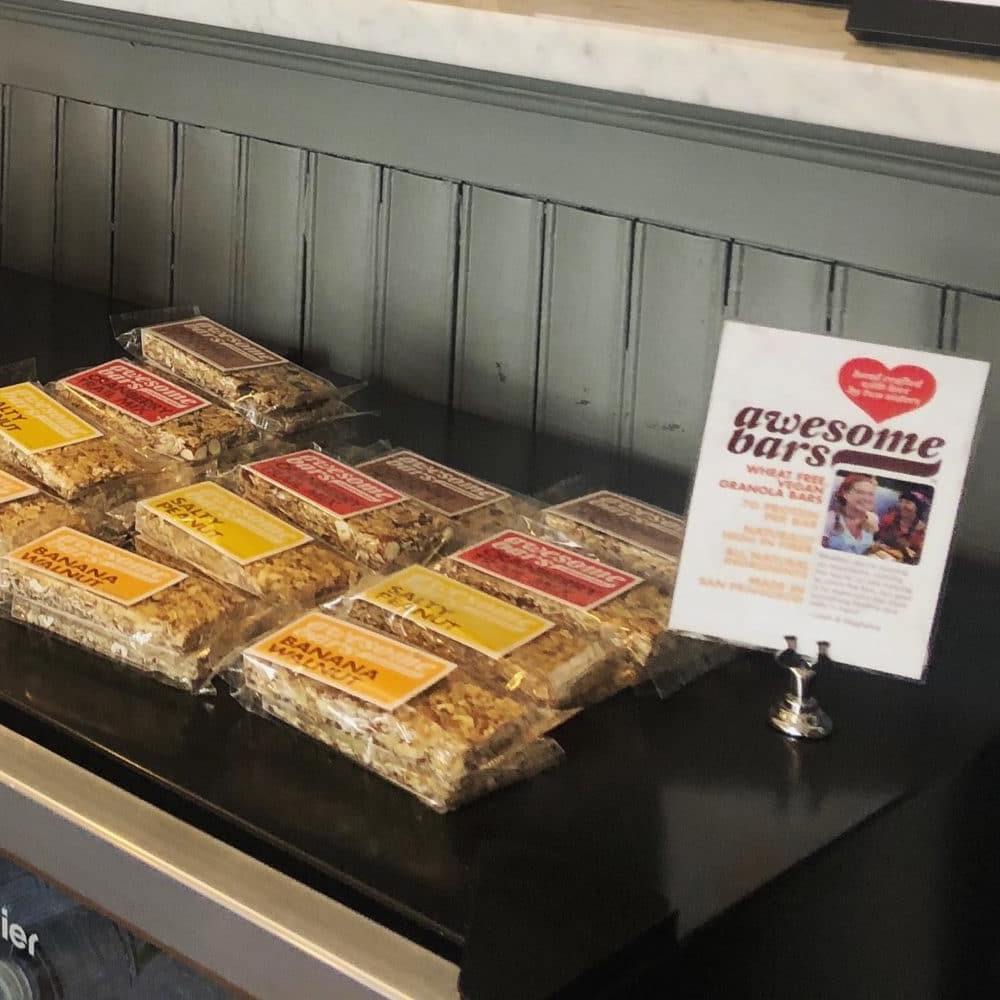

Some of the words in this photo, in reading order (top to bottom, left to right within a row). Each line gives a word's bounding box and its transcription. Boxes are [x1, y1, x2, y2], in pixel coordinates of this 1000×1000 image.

[727, 428, 832, 468] bars
[733, 406, 946, 459] awesome
[718, 479, 784, 497] GRANOLA
[170, 496, 224, 525] SALTY
[21, 551, 104, 587] WALNUT
[31, 545, 118, 585] BANANA
[281, 635, 378, 681] BANANA
